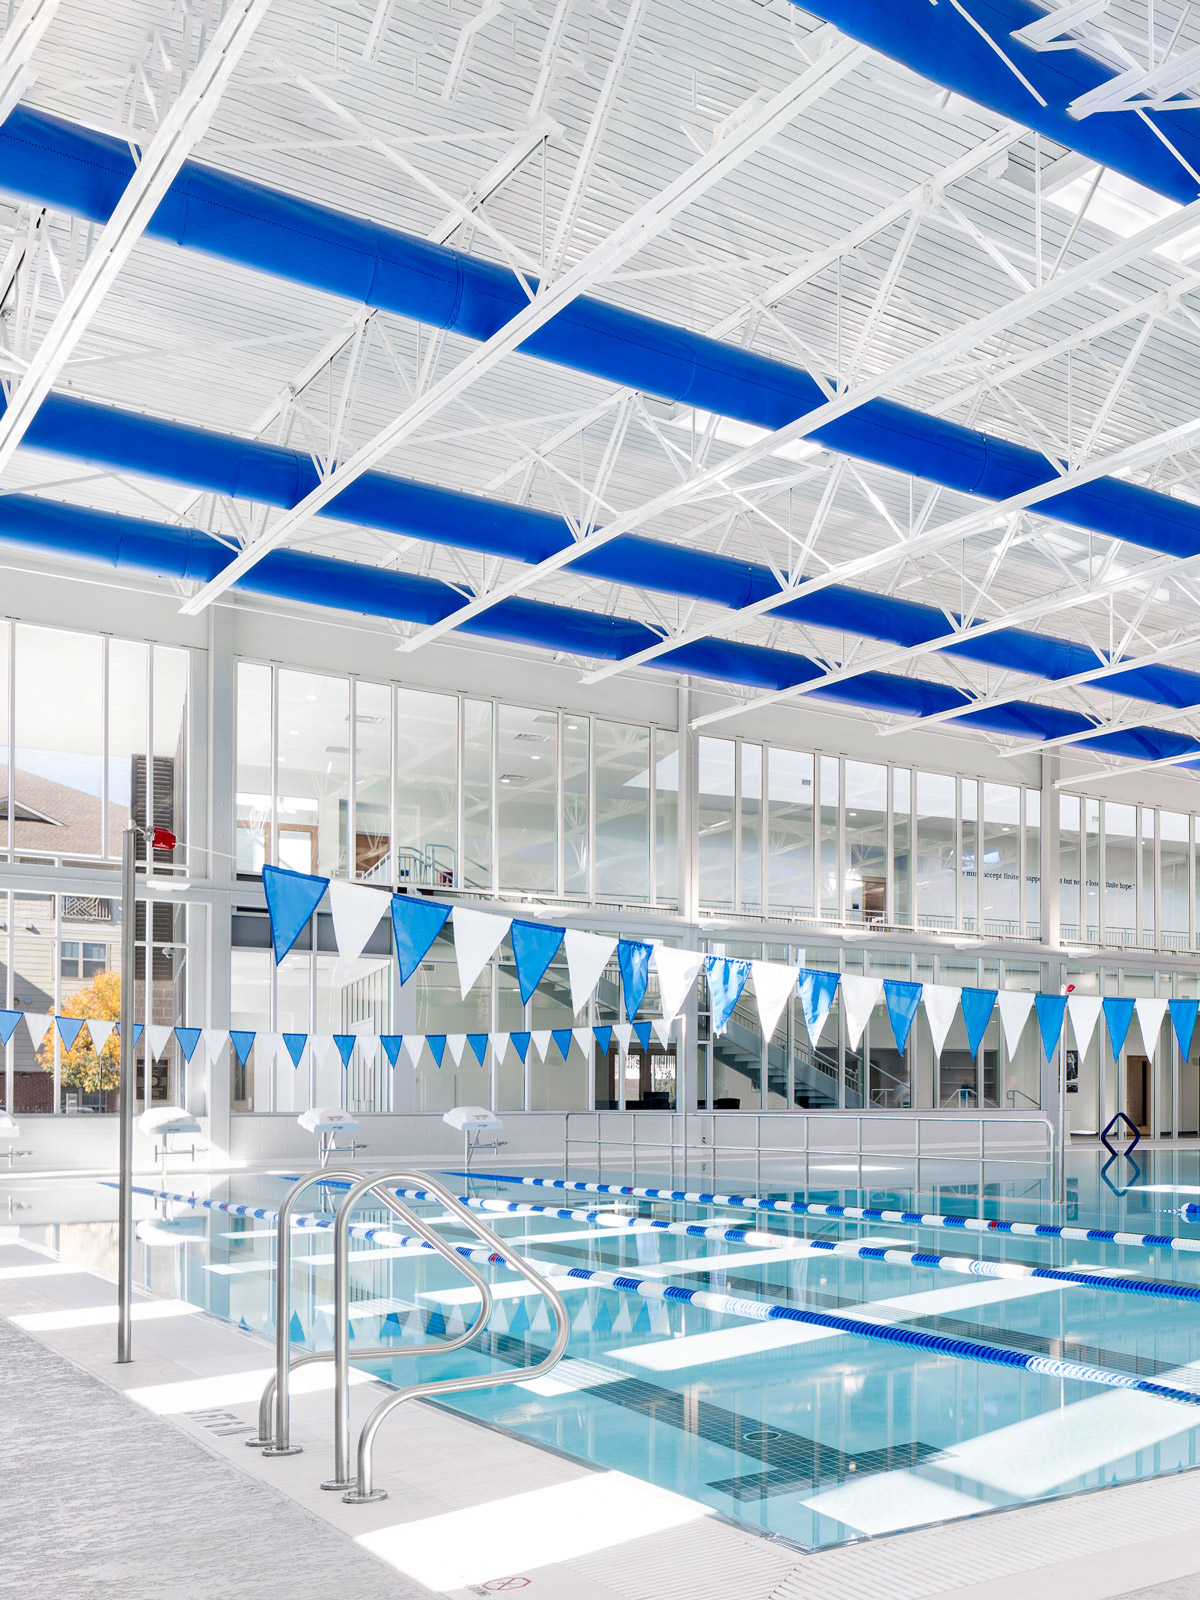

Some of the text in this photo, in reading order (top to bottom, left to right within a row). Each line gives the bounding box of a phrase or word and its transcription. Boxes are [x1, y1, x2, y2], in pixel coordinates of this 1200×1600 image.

[984, 872, 1002, 880] accept
[1003, 872, 1019, 880] finite
[190, 1413, 238, 1422] FT
